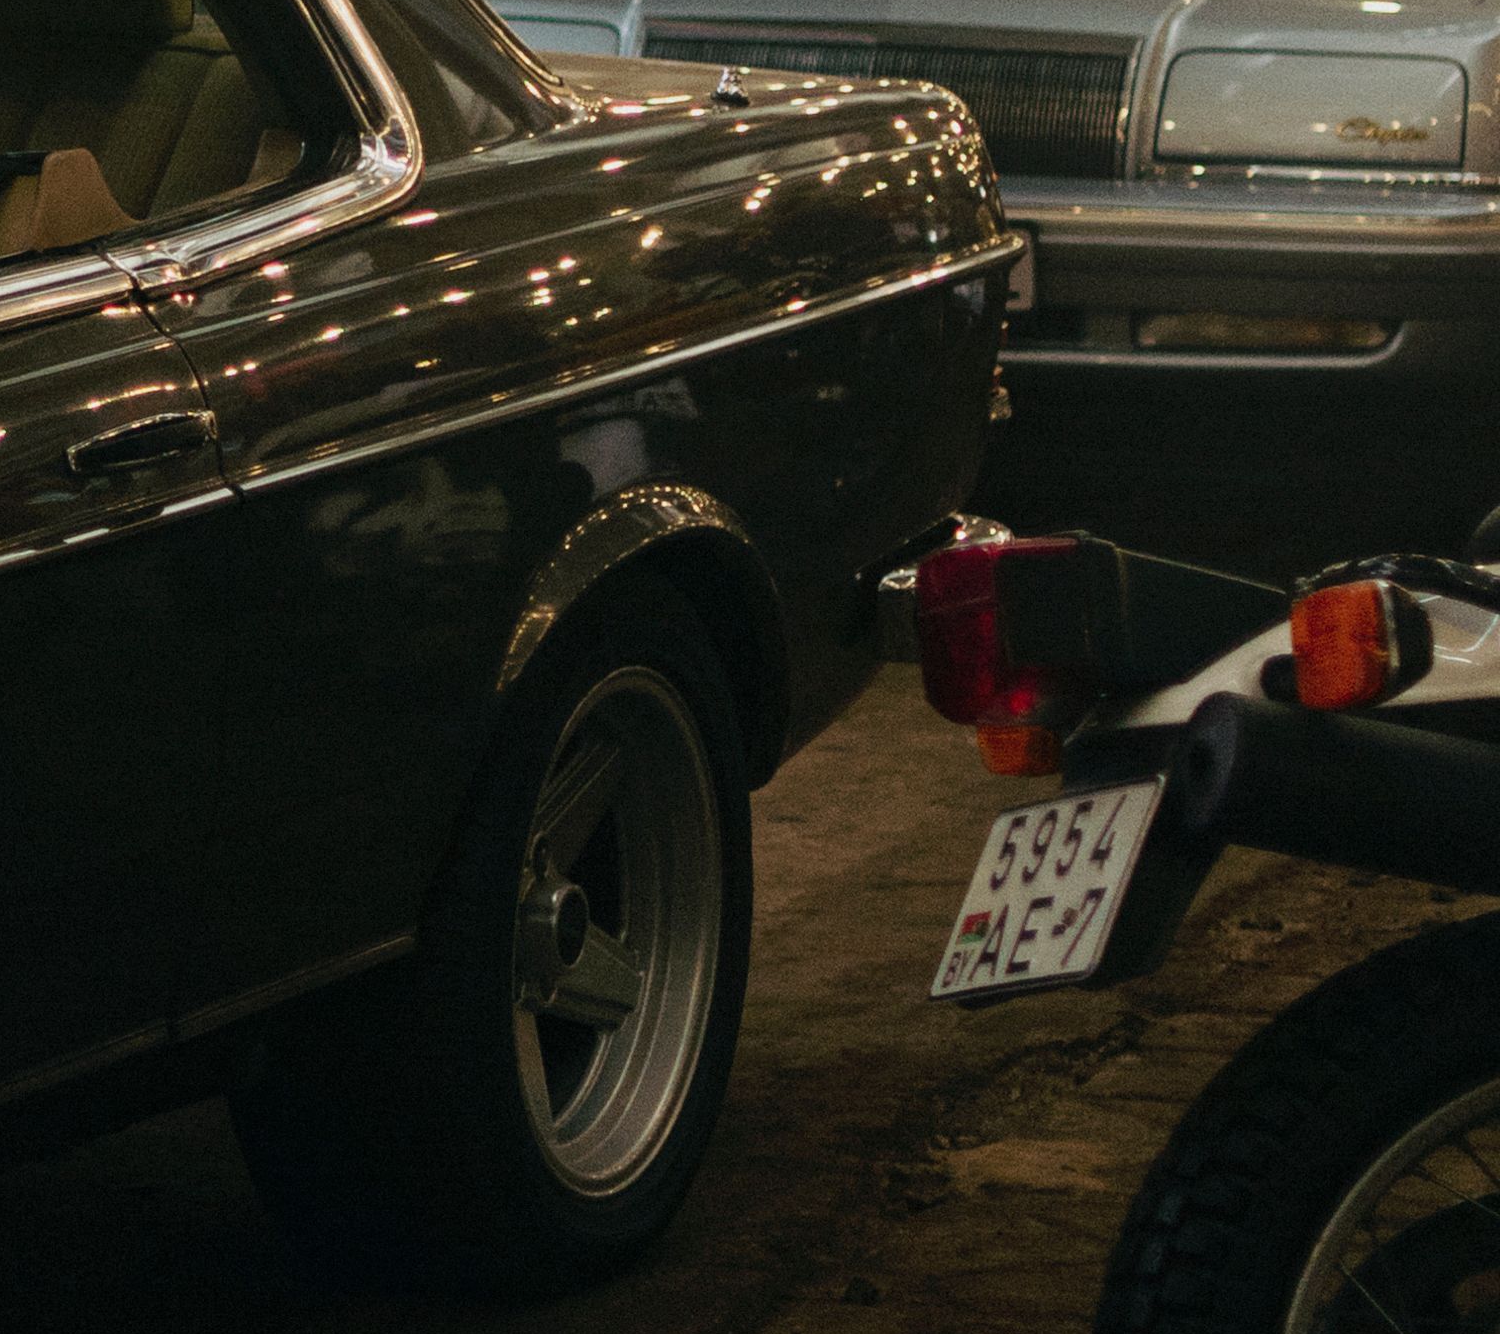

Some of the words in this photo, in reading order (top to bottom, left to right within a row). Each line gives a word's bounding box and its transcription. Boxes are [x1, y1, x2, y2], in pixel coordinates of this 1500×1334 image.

[989, 793, 1127, 891] 5954
[941, 949, 975, 989] BY
[968, 886, 1107, 983] AE-7
